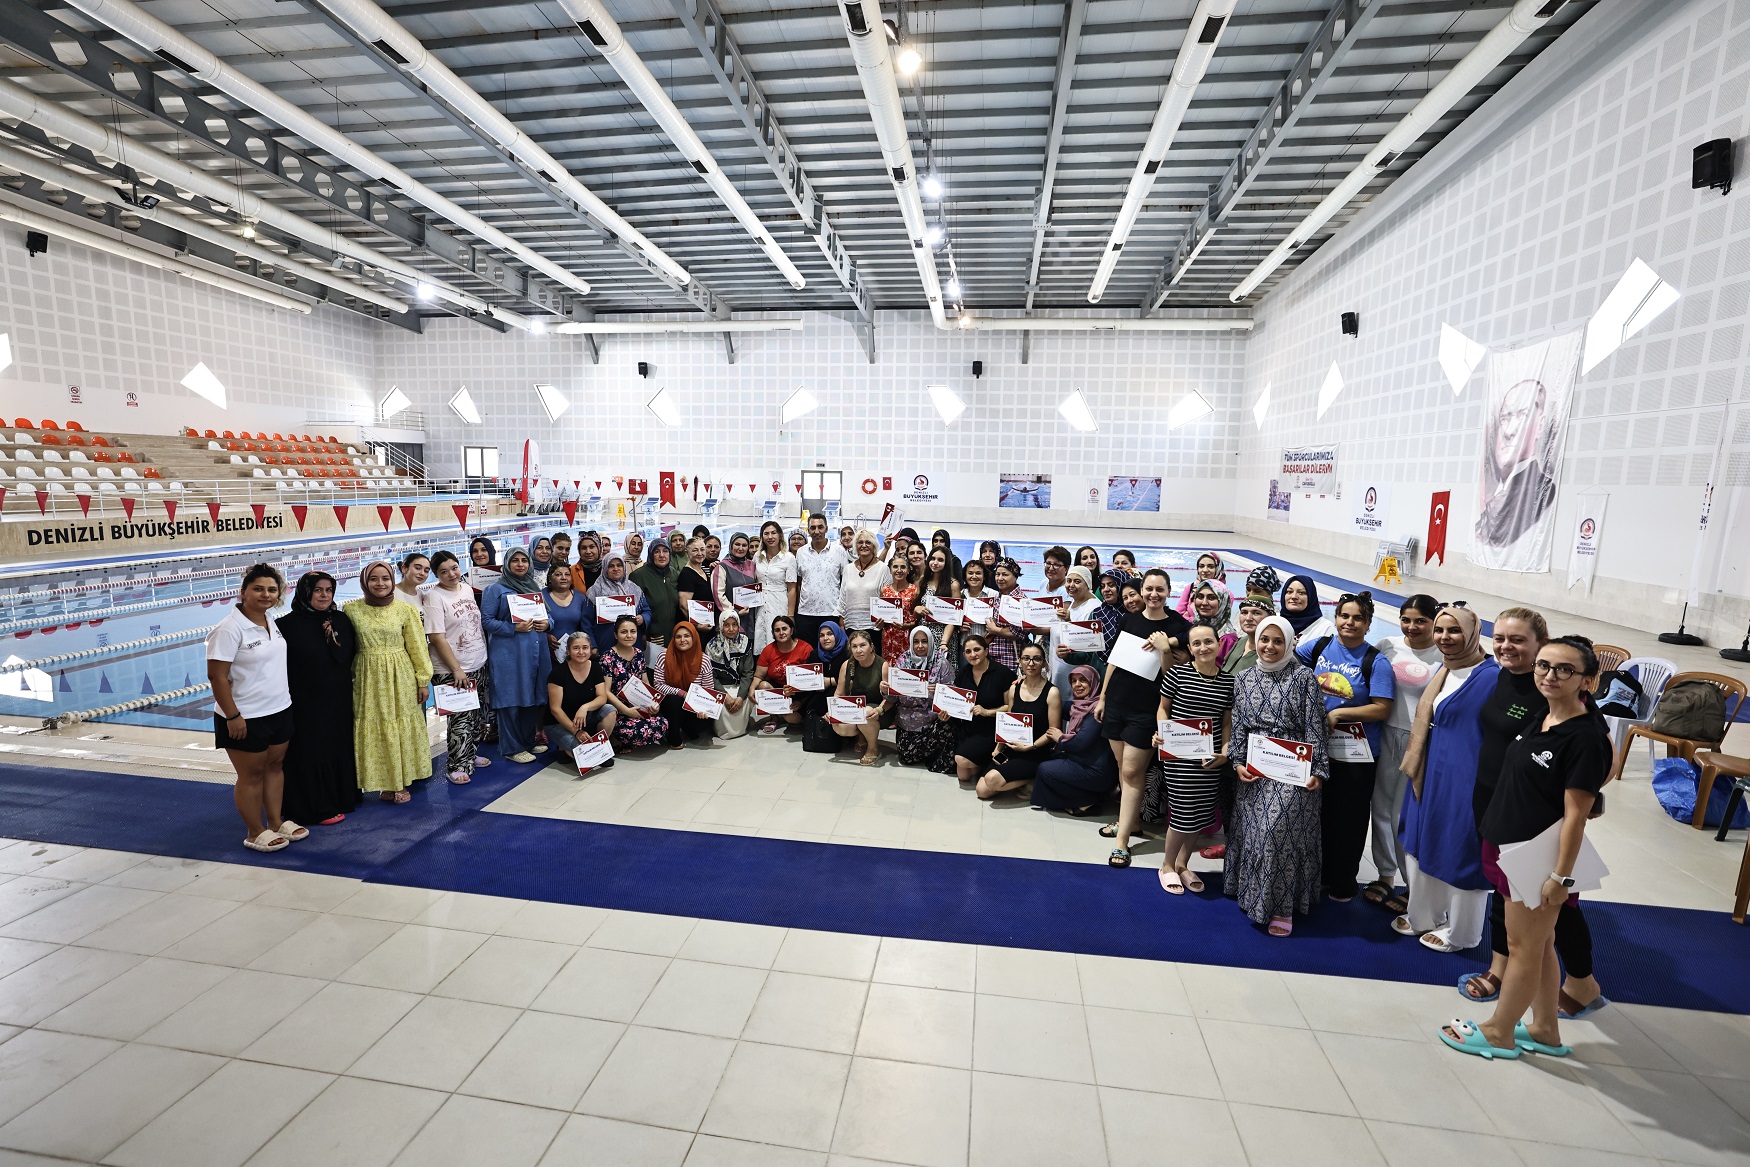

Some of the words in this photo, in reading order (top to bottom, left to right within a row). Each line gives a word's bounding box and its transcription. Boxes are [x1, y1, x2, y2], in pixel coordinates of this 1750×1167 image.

[1294, 451, 1334, 461] SPORCULARIMIZA
[1283, 464, 1310, 476] BAŞARILAR
[1311, 463, 1333, 475] DİLERİM
[27, 522, 105, 546] DENİZLİ
[110, 516, 210, 540] BÜYÜKŞEHİR
[453, 608, 465, 618] The
